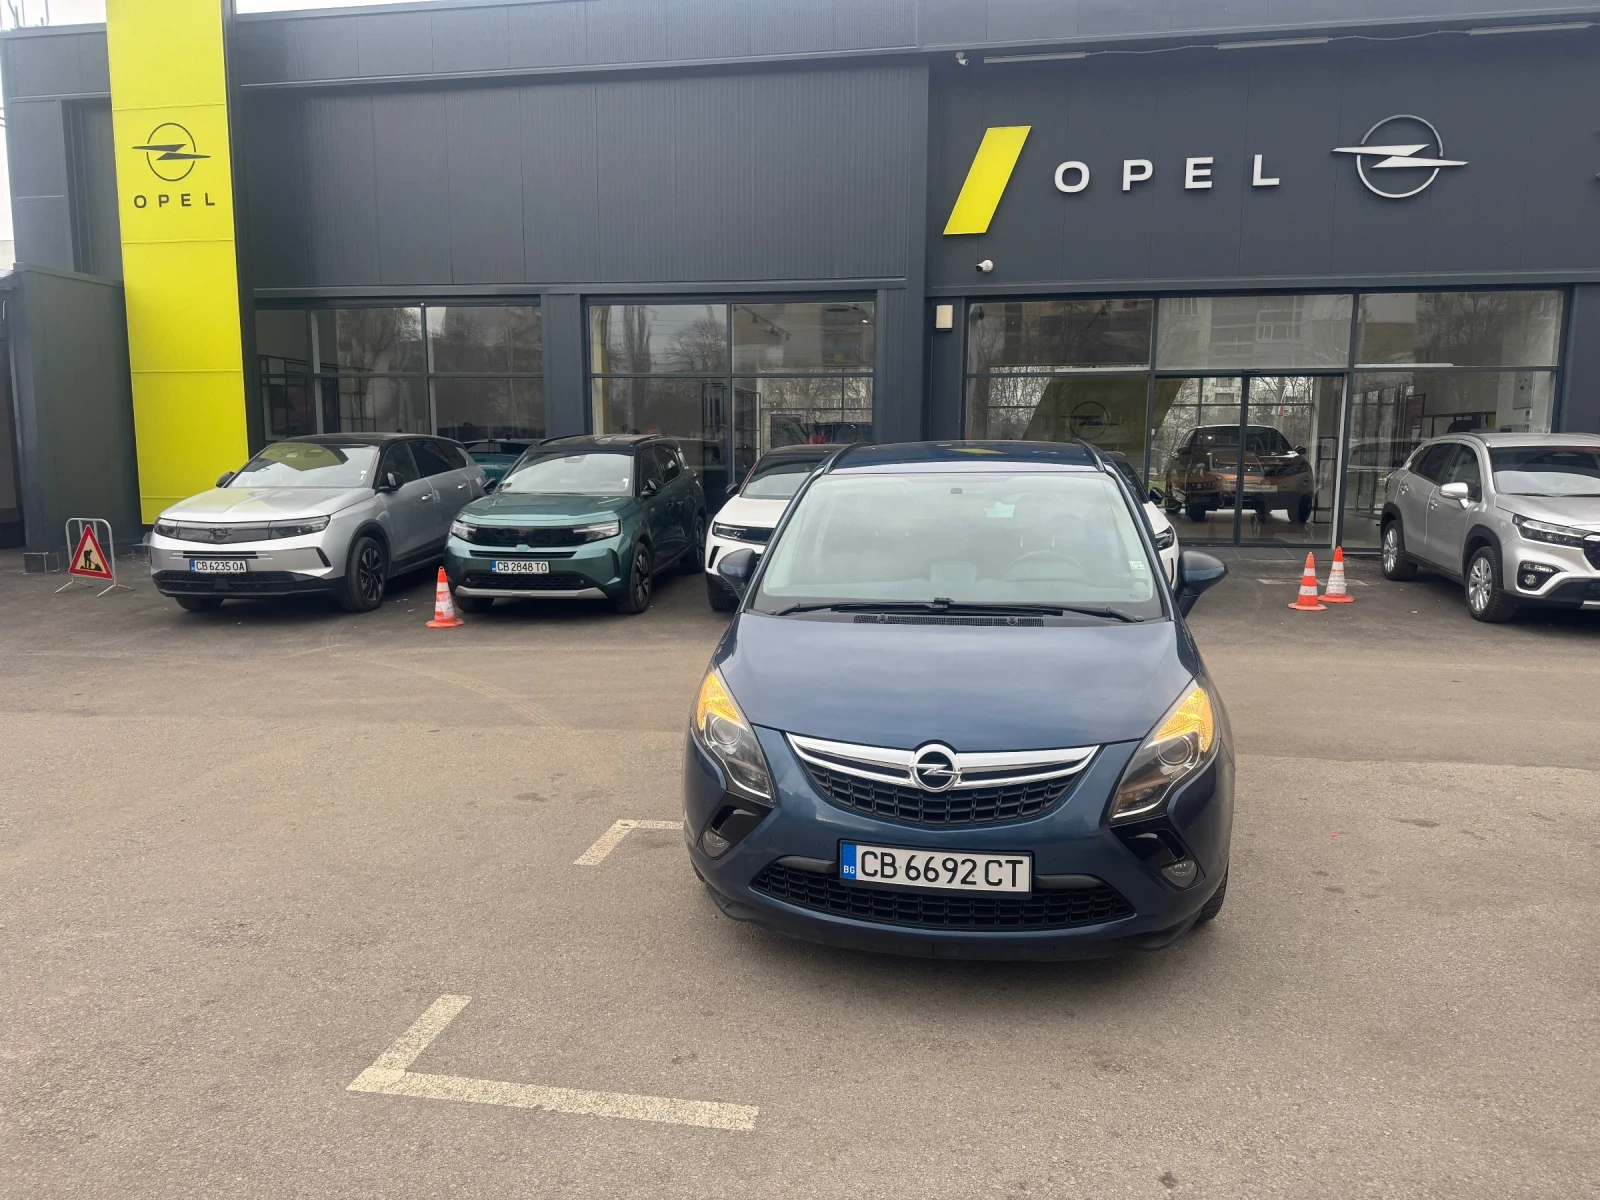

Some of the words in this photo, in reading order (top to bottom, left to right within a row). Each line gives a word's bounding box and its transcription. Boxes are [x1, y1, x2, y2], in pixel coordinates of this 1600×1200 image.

[1054, 154, 1280, 193] OPEL
[133, 192, 216, 209] OPEL
[196, 561, 208, 571] CB
[209, 561, 232, 571] 6235
[497, 561, 510, 571] CB
[510, 562, 534, 572] 2848
[843, 865, 856, 874] BG
[860, 850, 898, 879] CB
[904, 854, 977, 885] 6692
[984, 859, 1024, 888] CT
